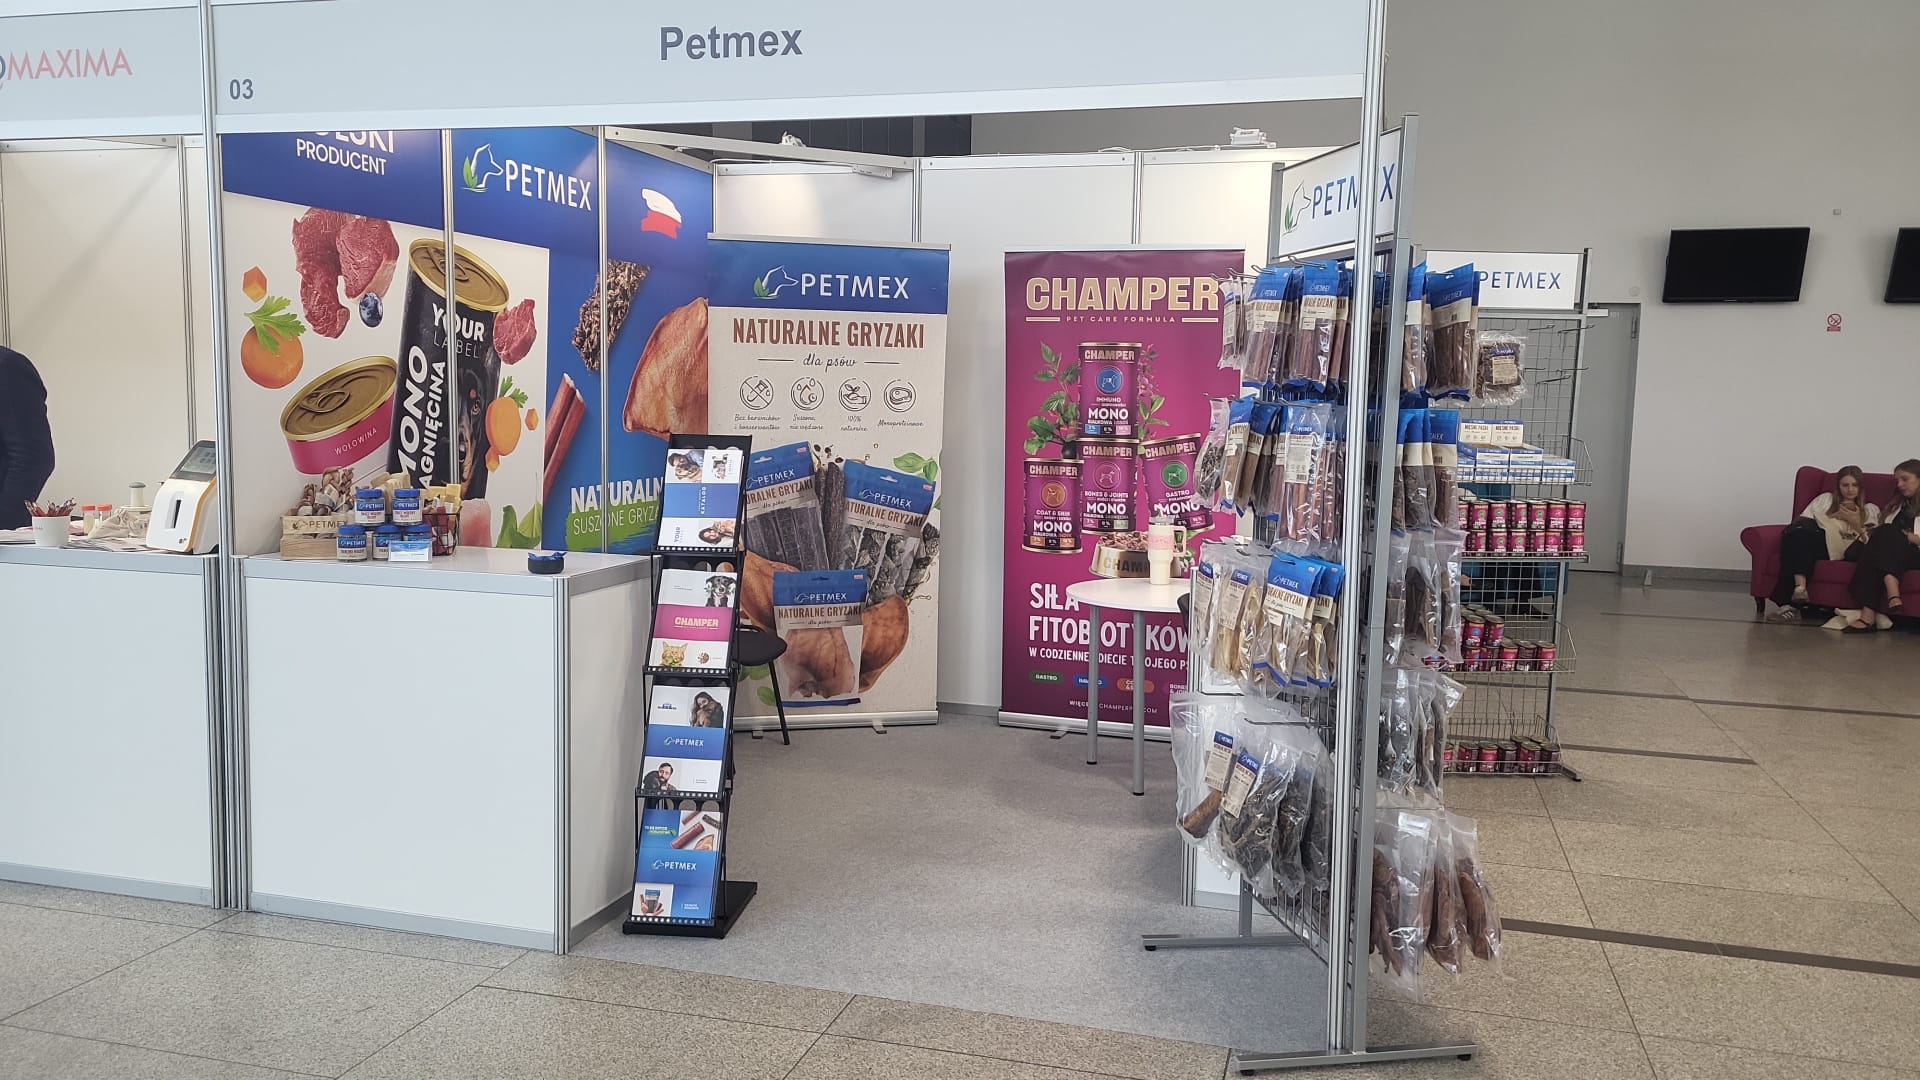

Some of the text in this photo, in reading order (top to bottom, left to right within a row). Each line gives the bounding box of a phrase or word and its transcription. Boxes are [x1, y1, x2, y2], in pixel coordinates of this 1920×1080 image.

[660, 25, 803, 61] Petmex
[229, 78, 254, 100] 03
[296, 138, 387, 176] PRODUCENT
[505, 158, 592, 211] PETMEX
[1312, 163, 1395, 219] PETMX
[801, 272, 909, 300] PETMEX
[1479, 271, 1561, 290] PETMEX
[1026, 276, 1220, 311] CHAMPER
[733, 317, 925, 349] NATURALNE GRYZAKI
[803, 353, 858, 373] dla psów
[1084, 350, 1135, 361] CHAMPER
[1088, 407, 1128, 420] MONO
[418, 361, 446, 488] AGNIĘCINA
[1083, 445, 1132, 457] CHAMPER
[1145, 441, 1196, 458] CHAMPER
[758, 468, 795, 484] PETMEX
[1029, 464, 1078, 476] CHAMPER
[571, 477, 663, 514] NATURALN
[747, 488, 777, 504] URALNE
[778, 479, 813, 497] GRYZAKI
[1165, 489, 1190, 498] GASTRO
[874, 492, 912, 508] PETMEX
[1086, 501, 1126, 515] MONO
[1154, 500, 1200, 516] MONO
[845, 501, 886, 520] ATURALNE
[1033, 520, 1072, 533] MONO
[809, 592, 847, 601] PETMEX
[1030, 582, 1080, 612] SIŁA
[778, 605, 862, 619] NATURALNE GRYZAKI
[674, 616, 719, 627] CHAMPER
[1029, 615, 1189, 653] FITOBOTKÓW
[1029, 647, 1037, 657] W
[1039, 647, 1090, 663] CODZIENNE
[1098, 652, 1127, 666] DIECIE
[1130, 654, 1177, 670] TOJEGO
[1069, 700, 1089, 708] WIĘCE
[675, 738, 705, 747] PETMEX
[664, 861, 697, 871] PETMEX
